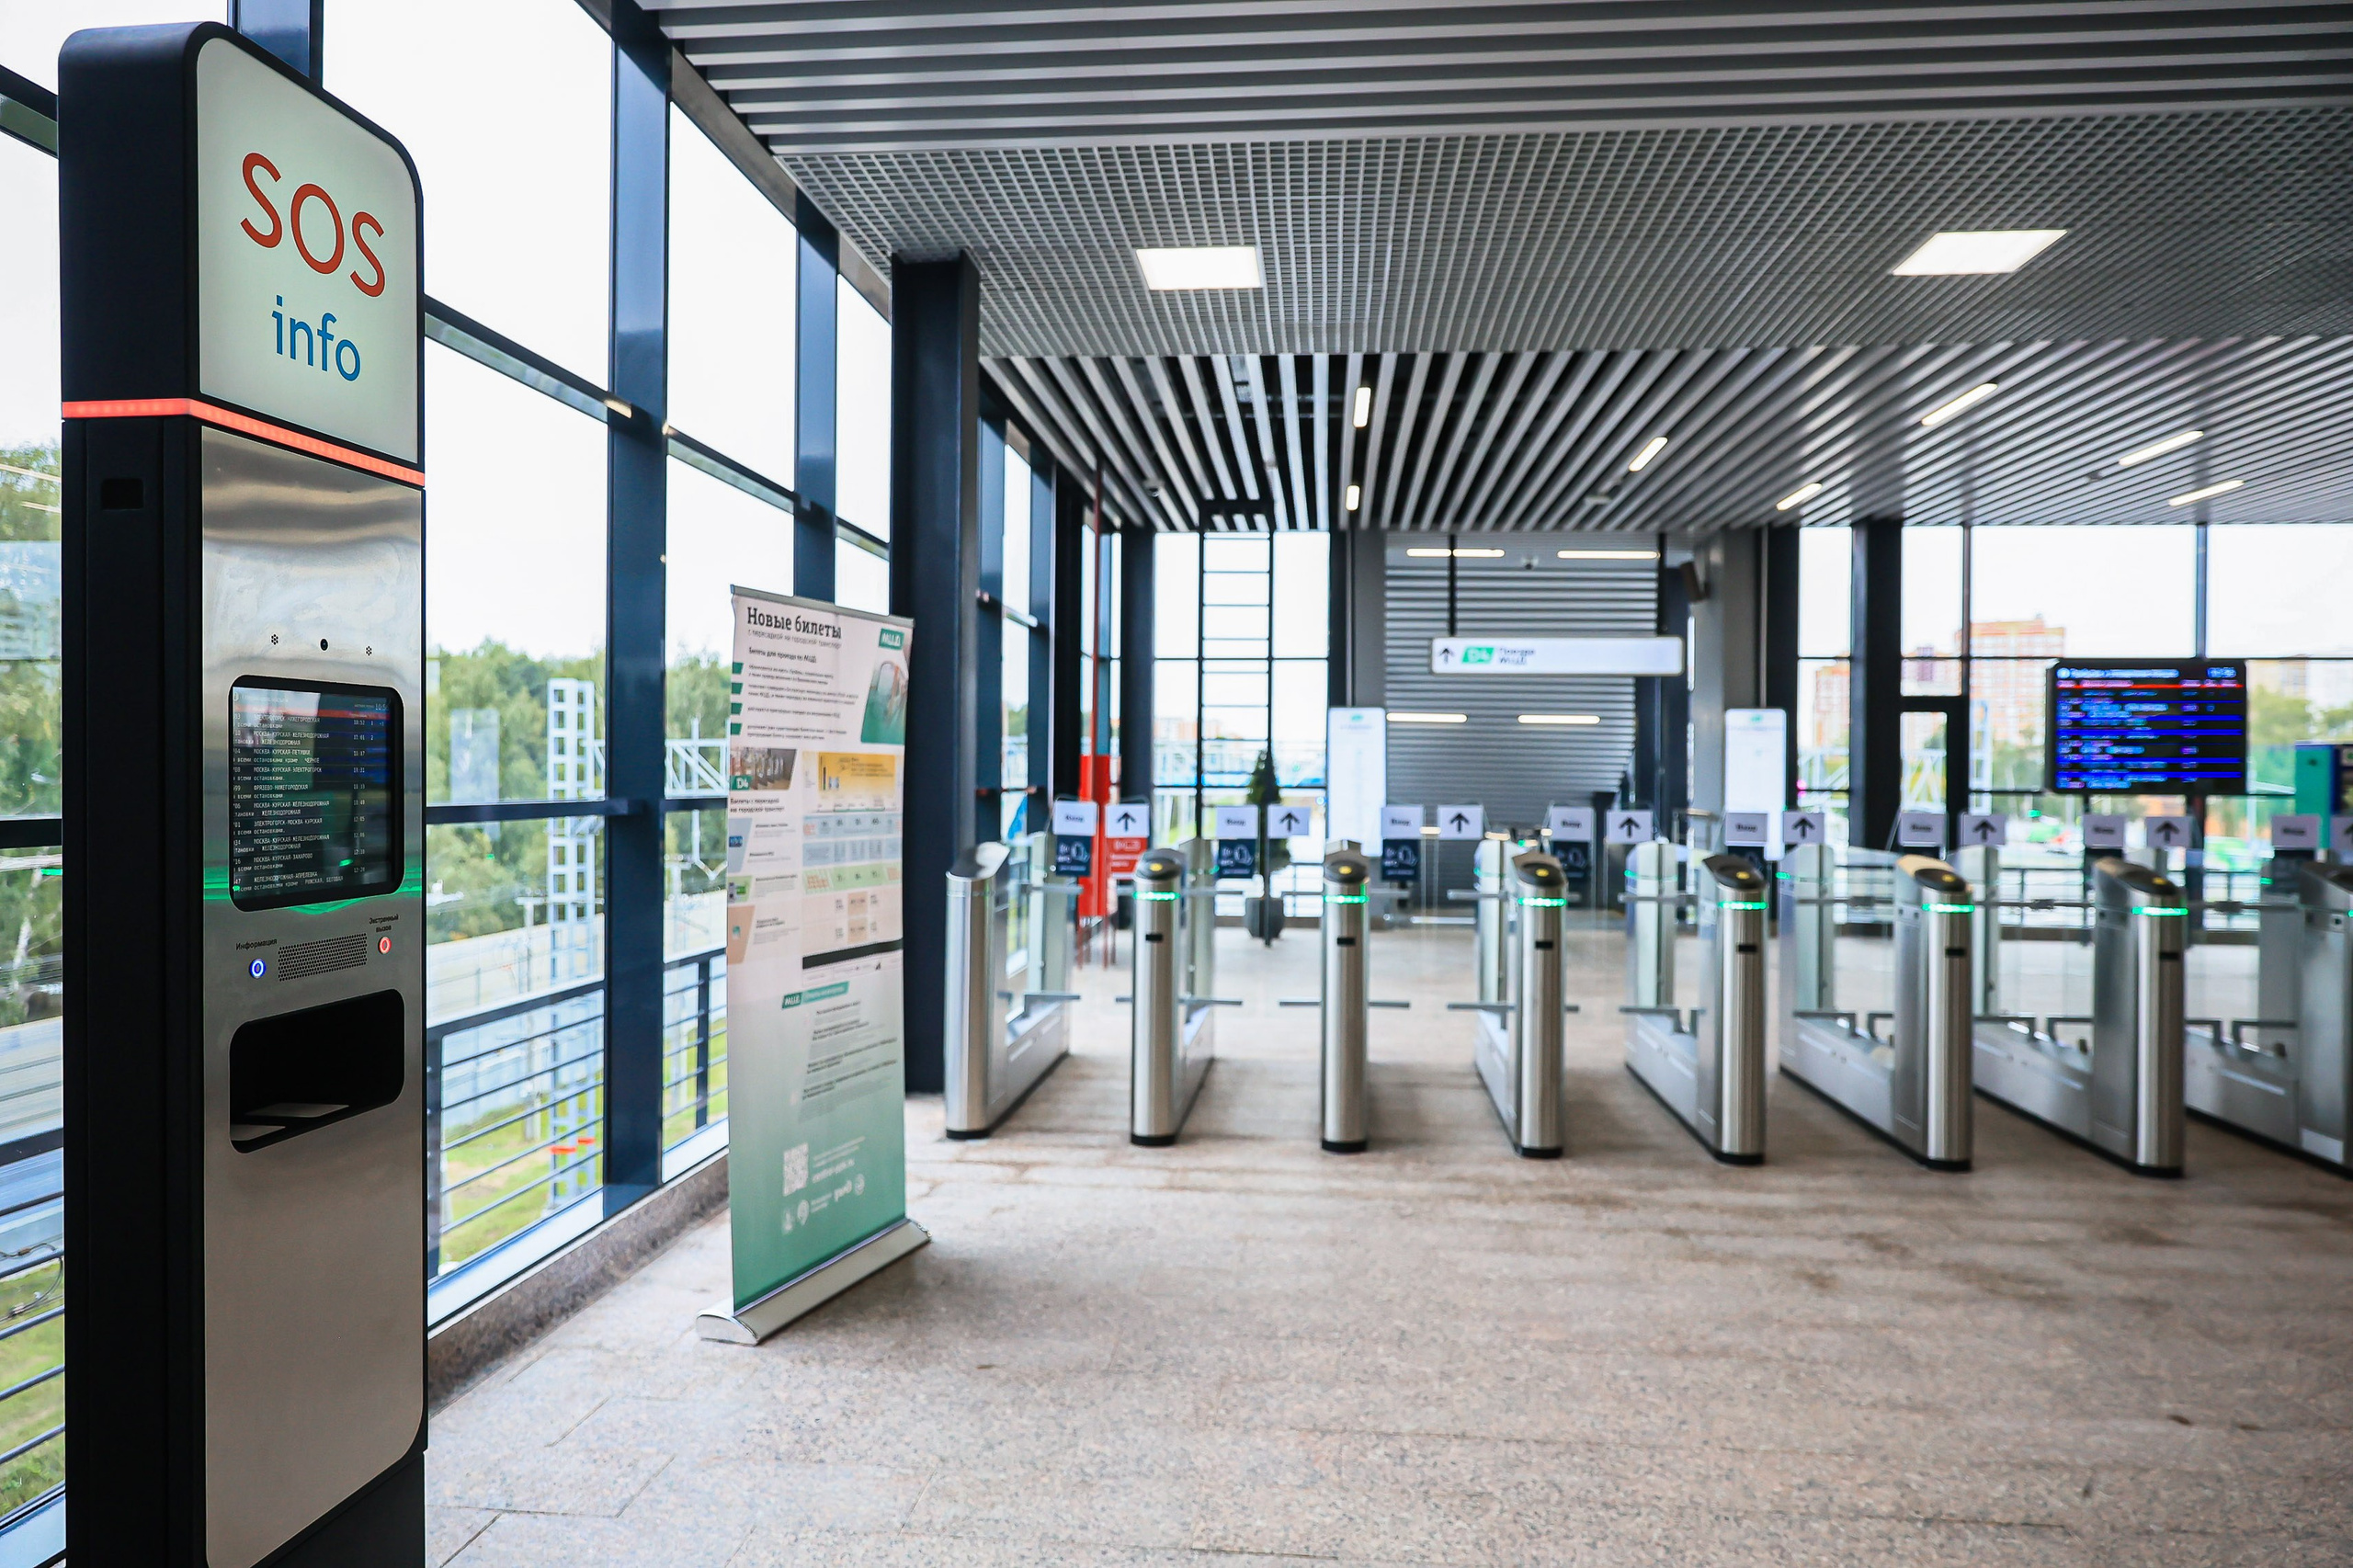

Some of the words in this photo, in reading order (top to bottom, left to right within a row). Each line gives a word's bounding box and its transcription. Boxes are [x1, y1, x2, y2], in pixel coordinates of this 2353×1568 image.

[240, 152, 386, 298] SOS
[271, 295, 361, 382] info
[747, 607, 792, 631] Новые
[794, 615, 843, 640] билеты
[736, 778, 750, 790] D4
[369, 915, 399, 925] Экстренный
[375, 925, 392, 933] вызов
[235, 938, 278, 950] Информация
